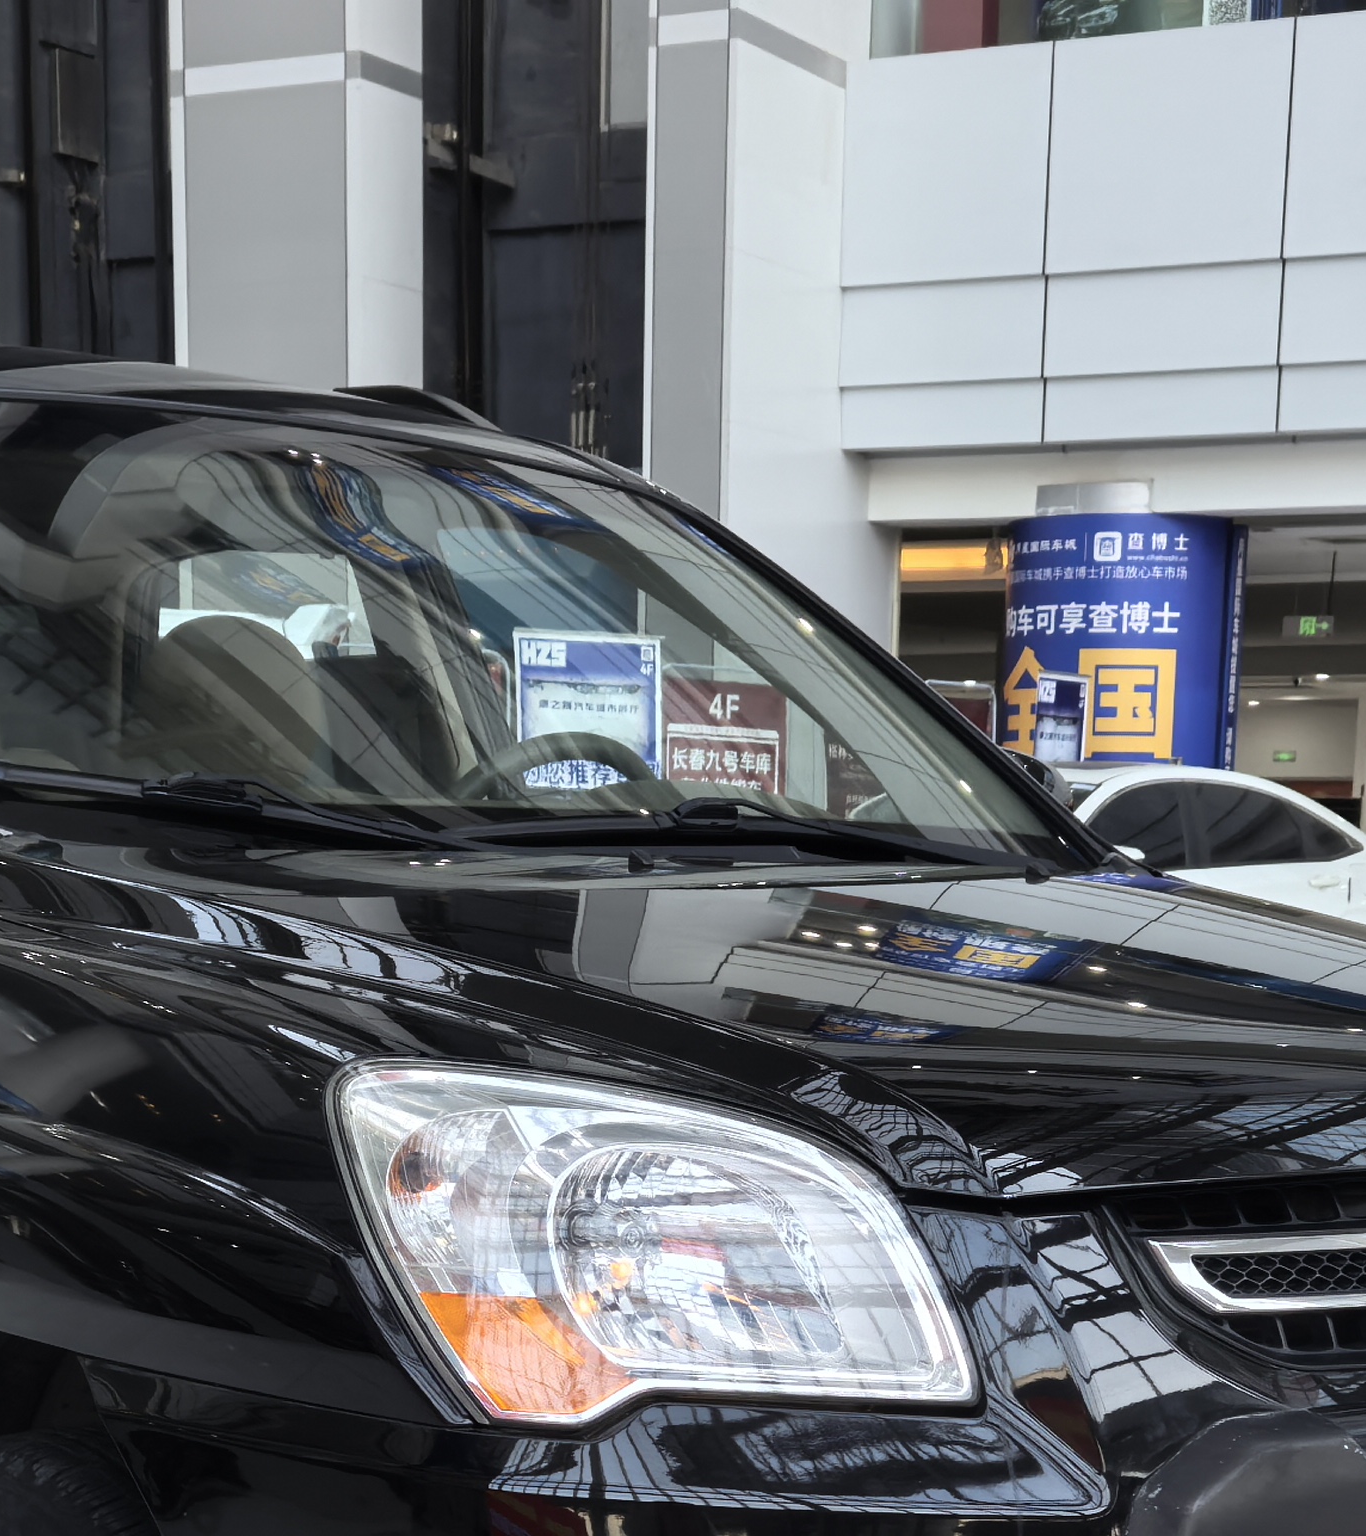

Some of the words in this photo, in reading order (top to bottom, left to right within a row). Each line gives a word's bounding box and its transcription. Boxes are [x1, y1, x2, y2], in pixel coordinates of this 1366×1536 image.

[1127, 532, 1190, 551] 查博士
[521, 640, 567, 668] HZS
[708, 693, 741, 720] 4F
[1002, 646, 1178, 760] 全国
[671, 746, 772, 776] 长春九号车库
